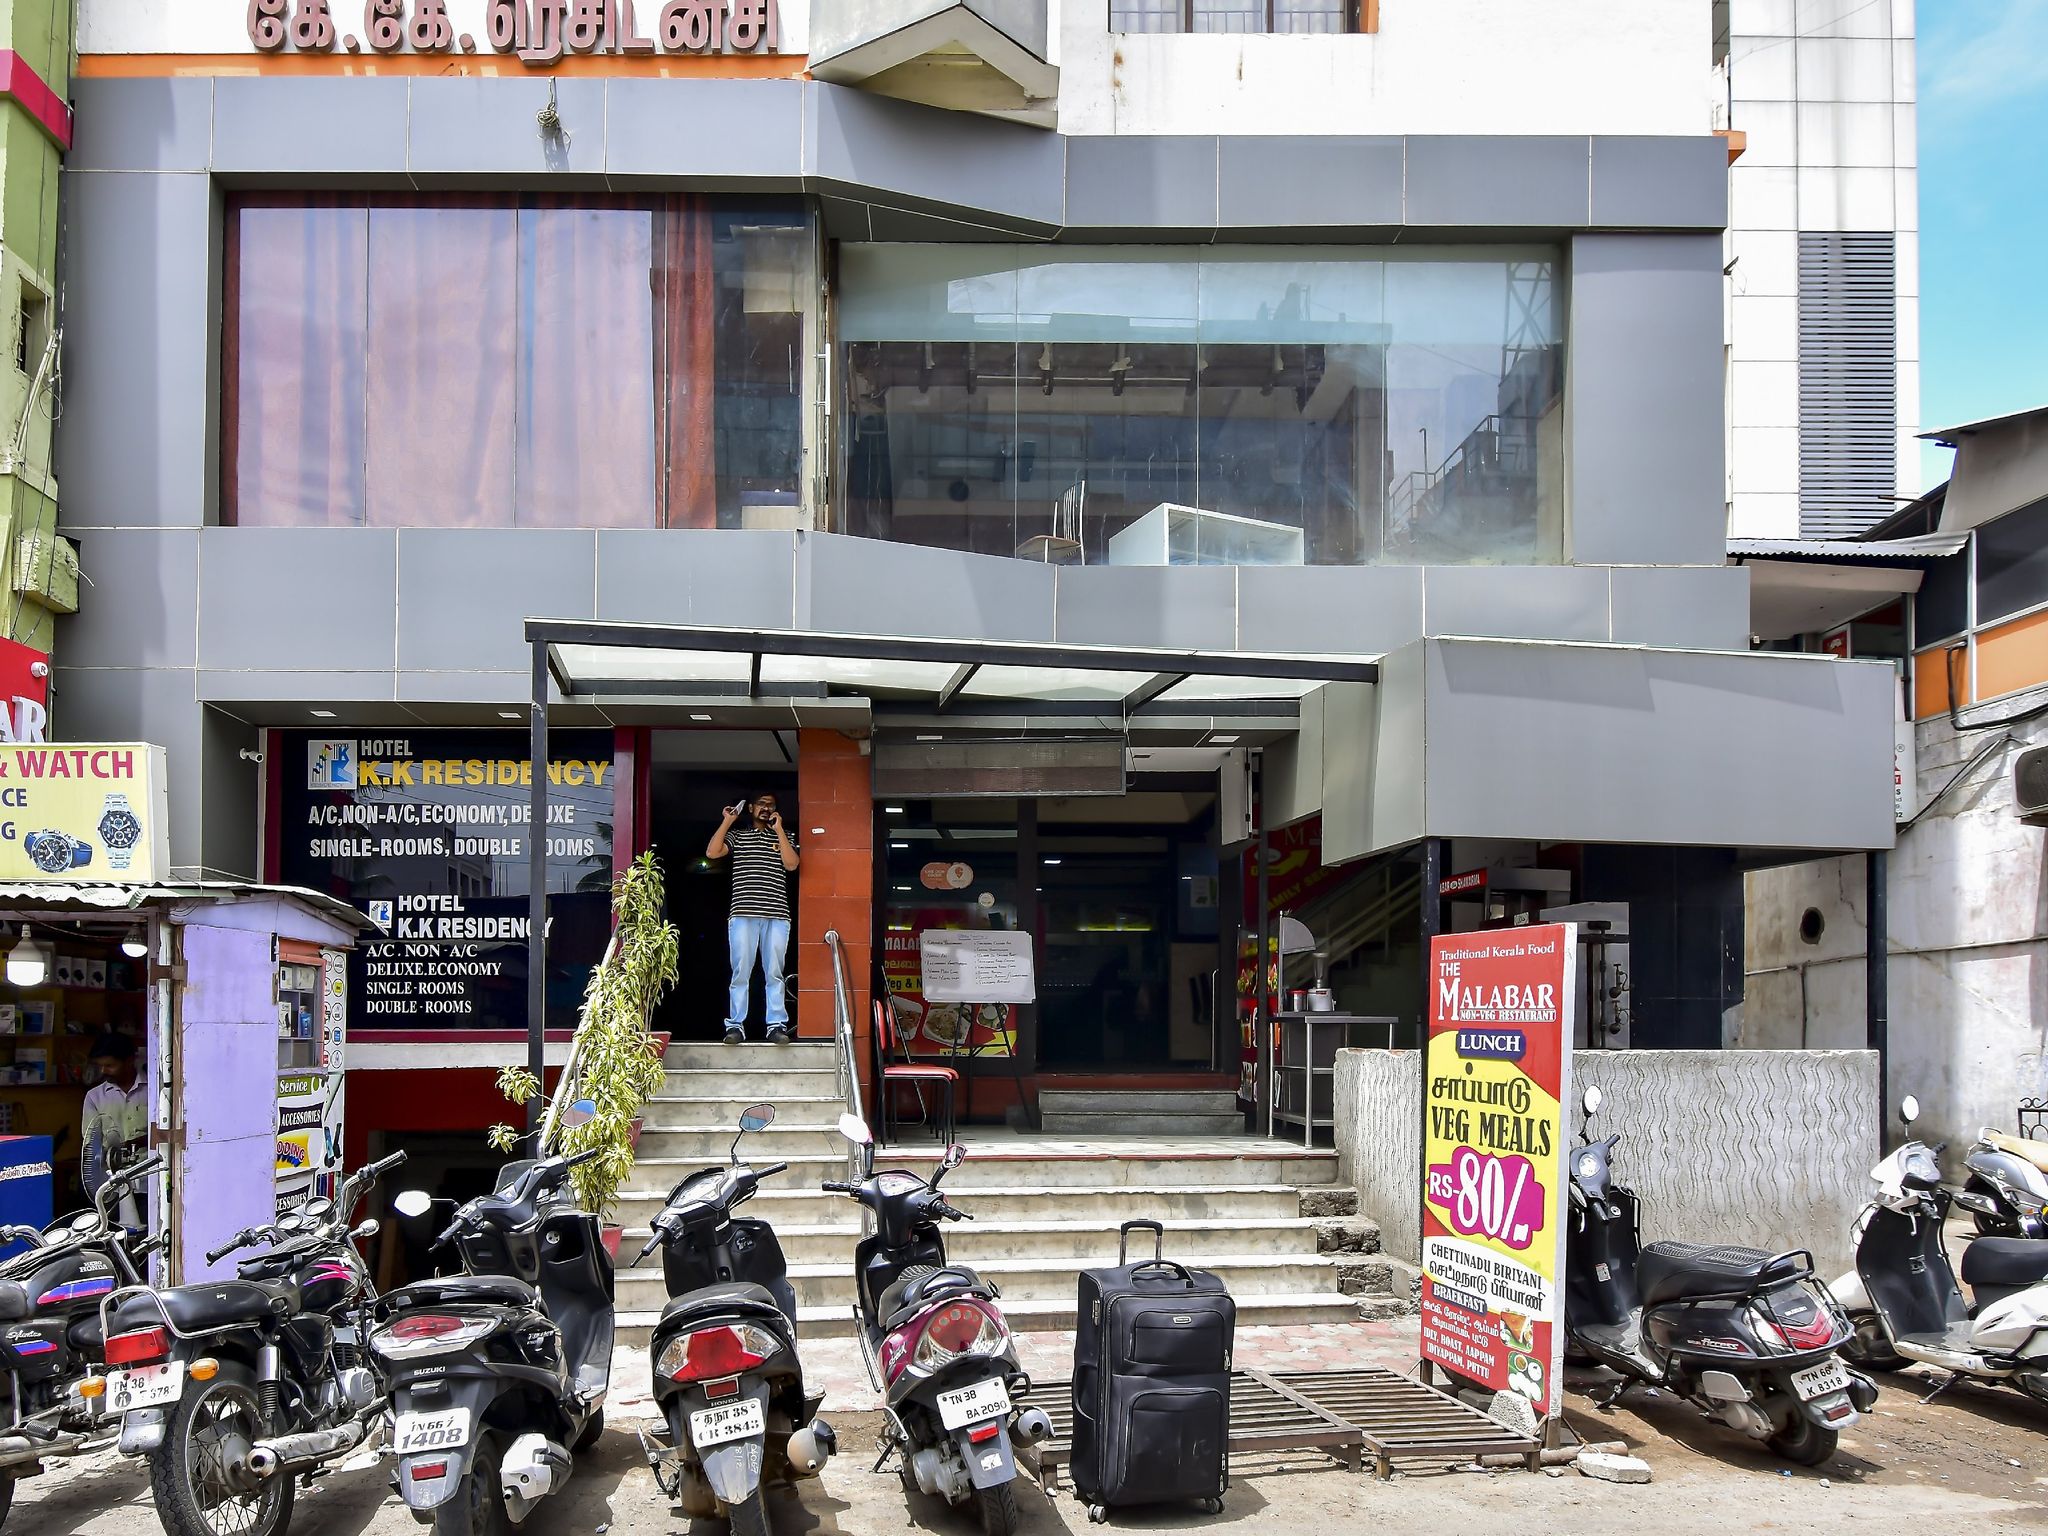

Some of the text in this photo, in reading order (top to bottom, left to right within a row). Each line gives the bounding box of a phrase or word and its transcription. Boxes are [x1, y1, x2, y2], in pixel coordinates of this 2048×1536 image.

[361, 740, 413, 756] HOTEL
[16, 751, 133, 778] WATCH
[360, 760, 415, 786] K.K
[454, 838, 521, 856] DOUBLE
[530, 838, 595, 857] OOMS
[398, 895, 465, 912] HOTEL
[1267, 882, 1301, 911] AMILY
[398, 917, 434, 939] K.K
[1440, 942, 1555, 961] Traditional Kerala Food
[1439, 962, 1461, 977] THE
[1438, 978, 1556, 1021] MALABAR
[1460, 1009, 1556, 1022] NON-VEG RESTAURANT
[1459, 1034, 1521, 1052] LUNCH
[280, 1079, 308, 1094] Service
[1431, 1062, 1531, 1115] சாப்பாடு
[281, 1109, 321, 1127] ACCESSORIES
[1431, 1106, 1551, 1157] VEG MEALS
[79, 1263, 109, 1274] HONDA
[1431, 1243, 1542, 1290] CHETTINADU BIRIYANI
[1465, 1344, 1495, 1368] AAPPAM
[413, 1366, 446, 1376] SUZUKI
[1466, 1359, 1491, 1380] PUTTU
[1805, 1365, 1833, 1383] TN 66
[1806, 1376, 1843, 1397] K 8318
[711, 1397, 739, 1407] HONDA
[949, 1389, 977, 1406] TN 38
[733, 1405, 749, 1418] 38
[966, 1400, 1008, 1420] BA 2090
[401, 1427, 463, 1450] 1408
